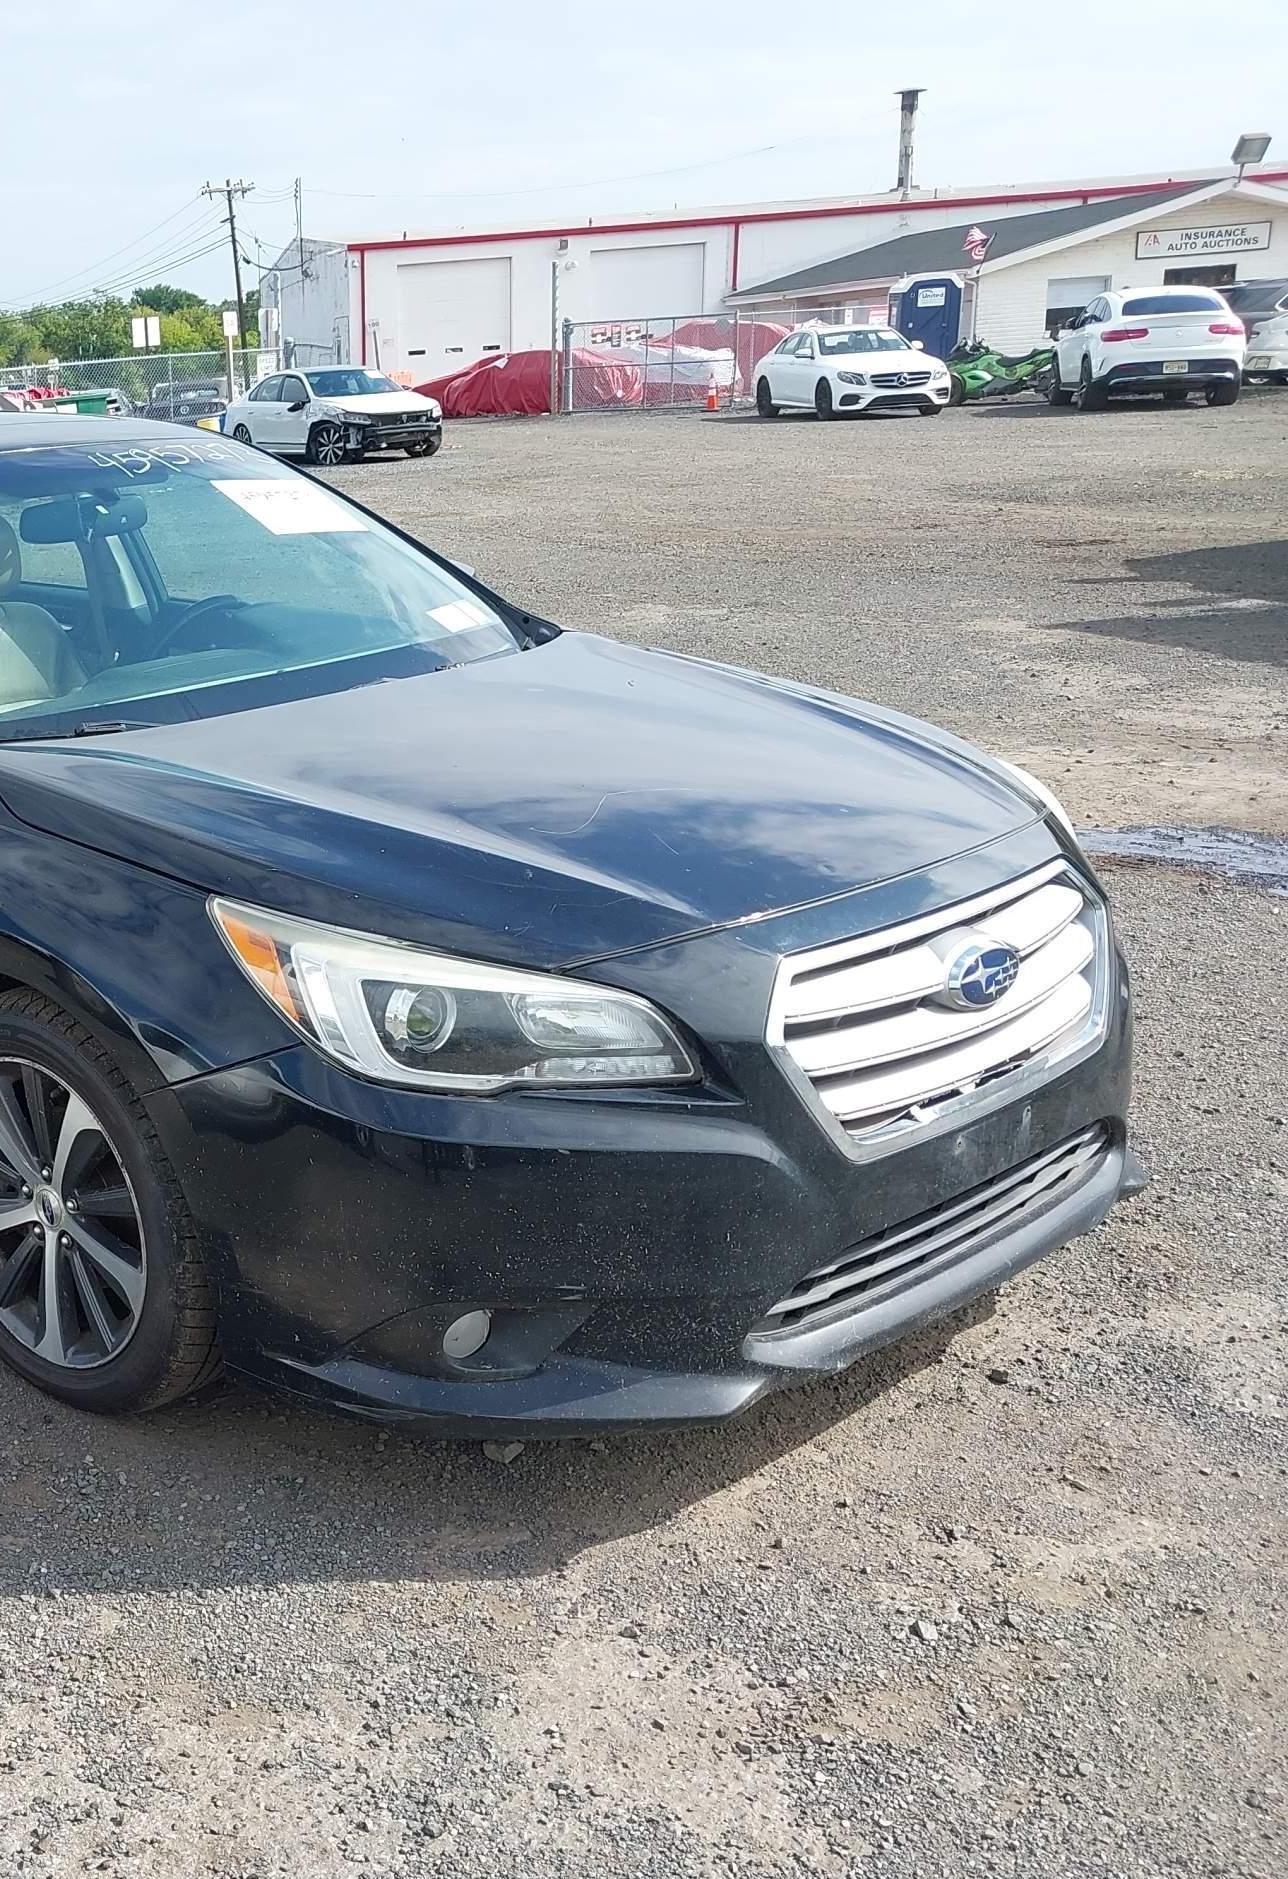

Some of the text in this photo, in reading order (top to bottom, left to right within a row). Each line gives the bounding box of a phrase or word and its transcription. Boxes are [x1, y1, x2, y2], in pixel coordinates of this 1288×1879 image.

[1180, 227, 1247, 241] INSURANCE
[1167, 236, 1259, 251] AUTO AUCTIONS
